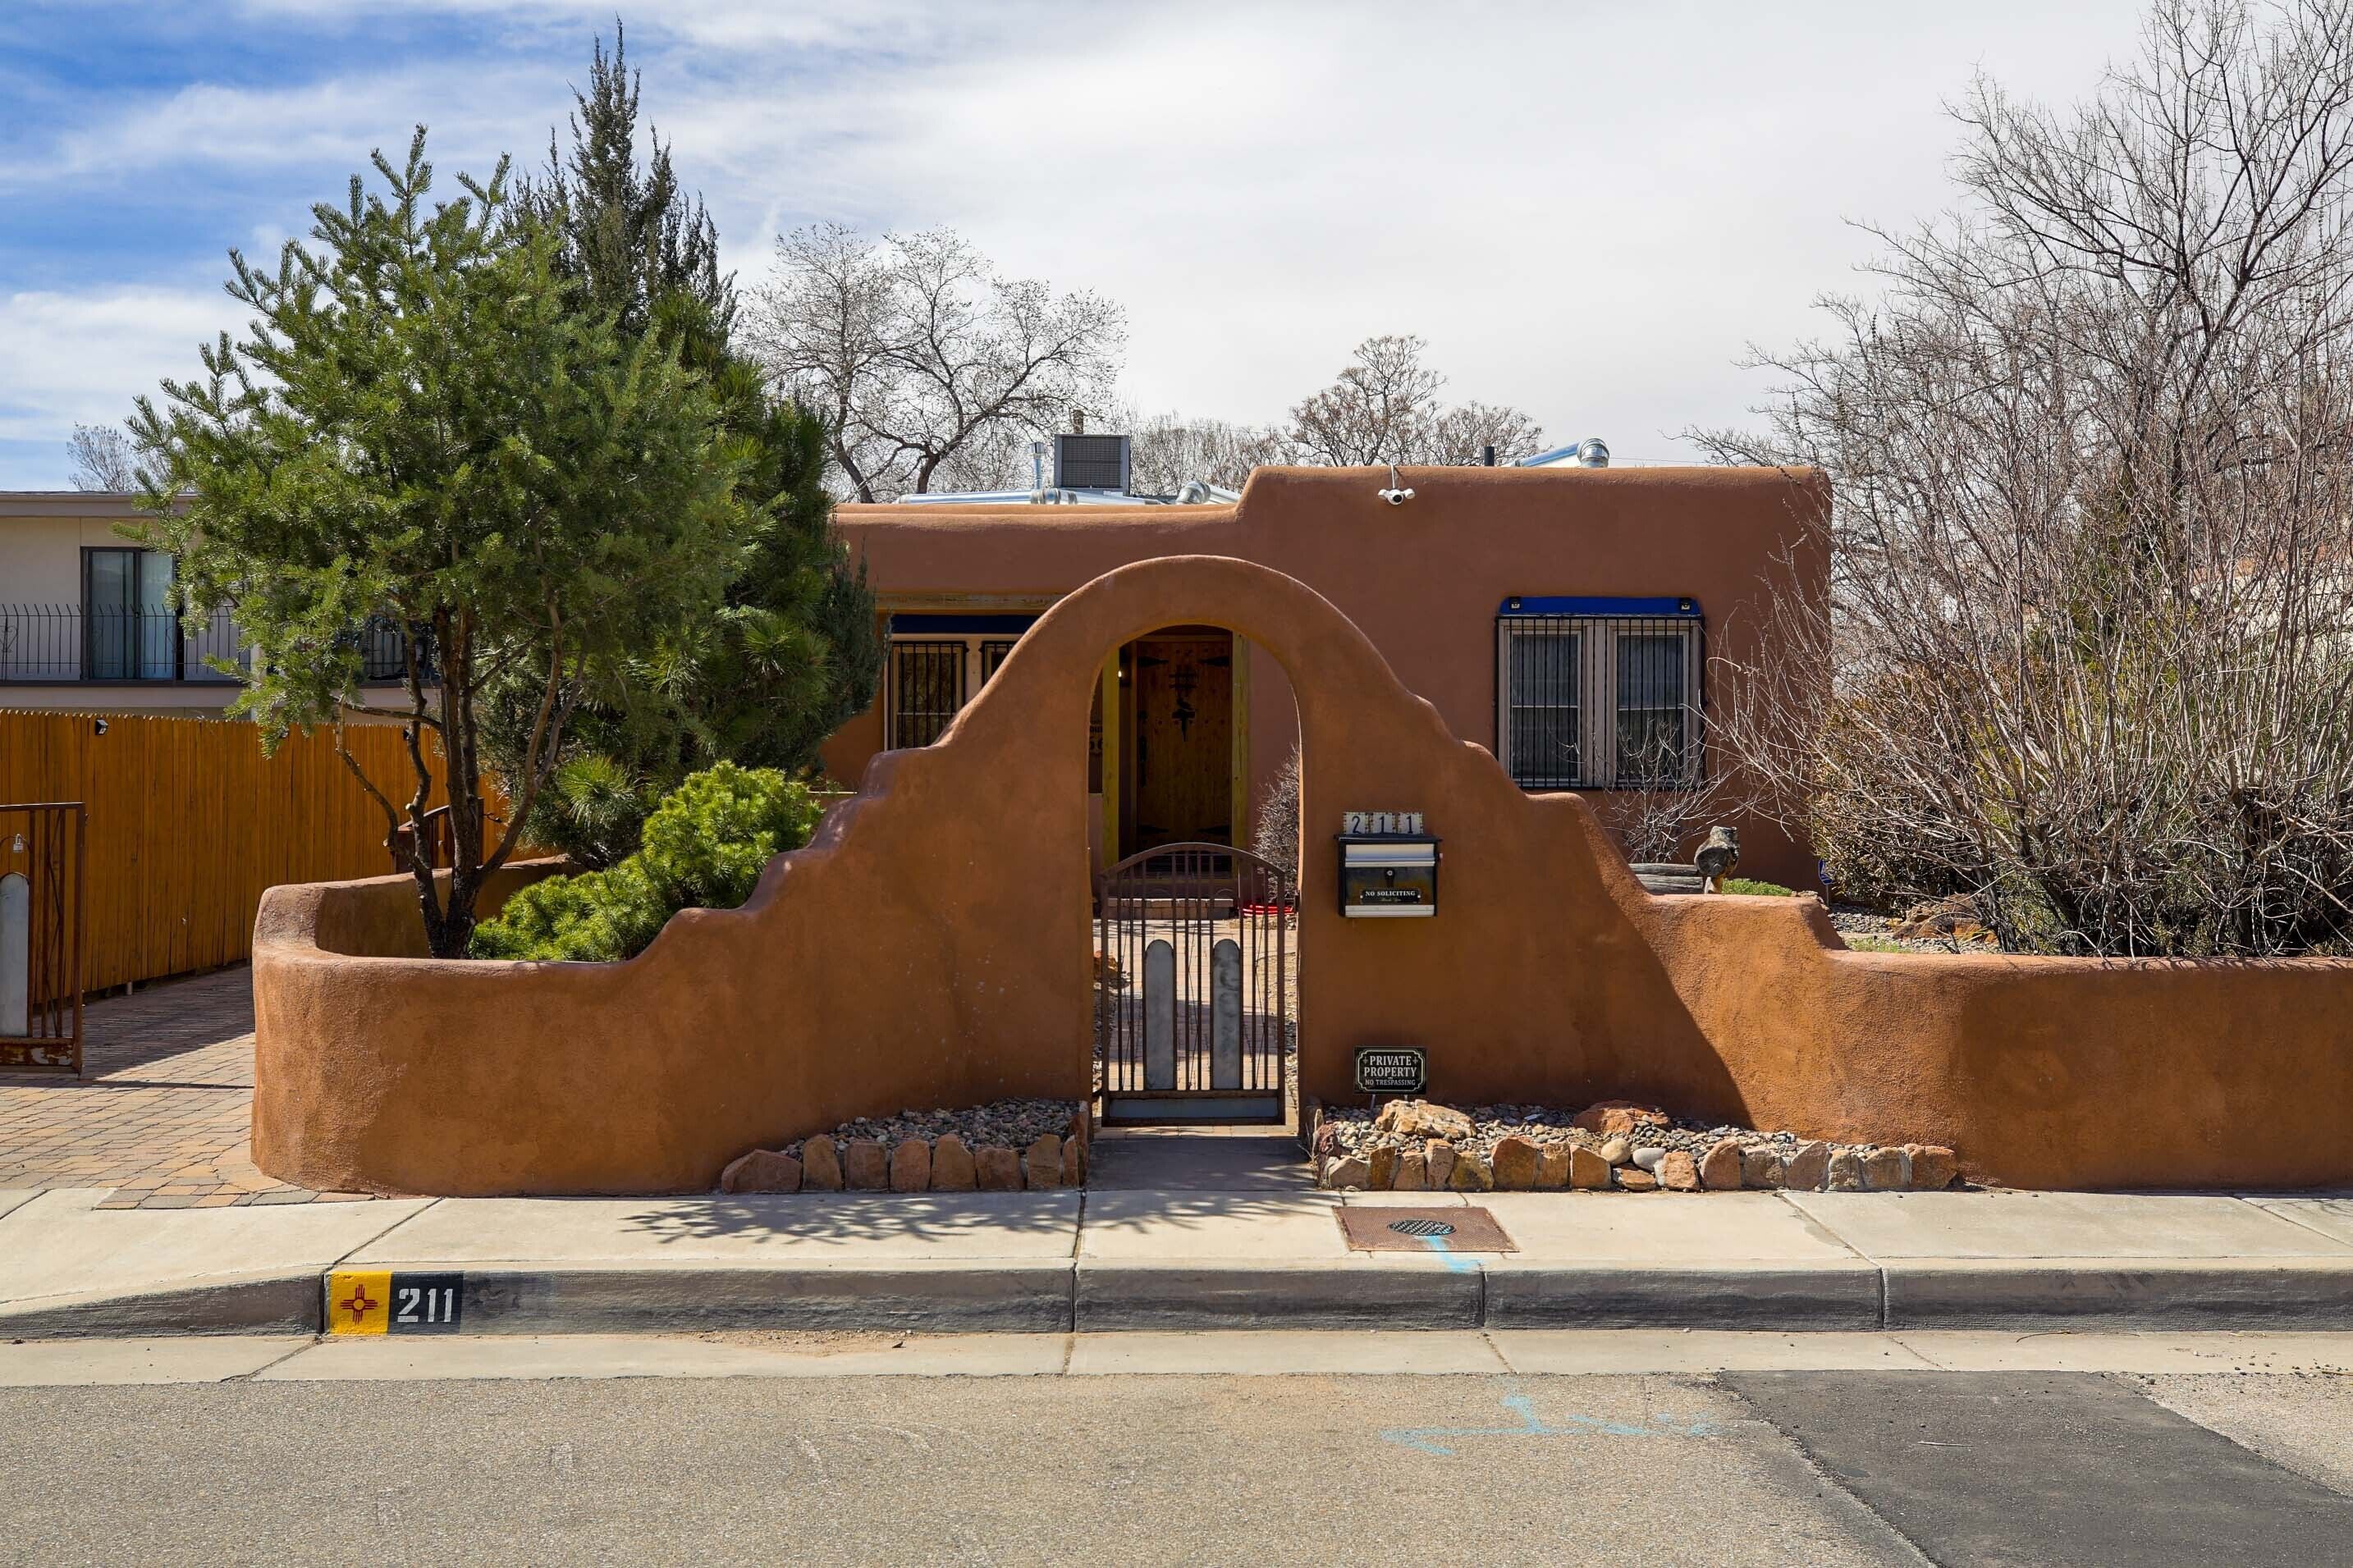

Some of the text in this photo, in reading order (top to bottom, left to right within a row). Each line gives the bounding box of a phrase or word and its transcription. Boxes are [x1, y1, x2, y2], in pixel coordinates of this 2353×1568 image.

[1352, 816, 1413, 834] 211
[1370, 1055, 1412, 1066] PRIVATE
[1364, 1067, 1417, 1077] PROPERTY
[396, 1288, 453, 1323] 211
